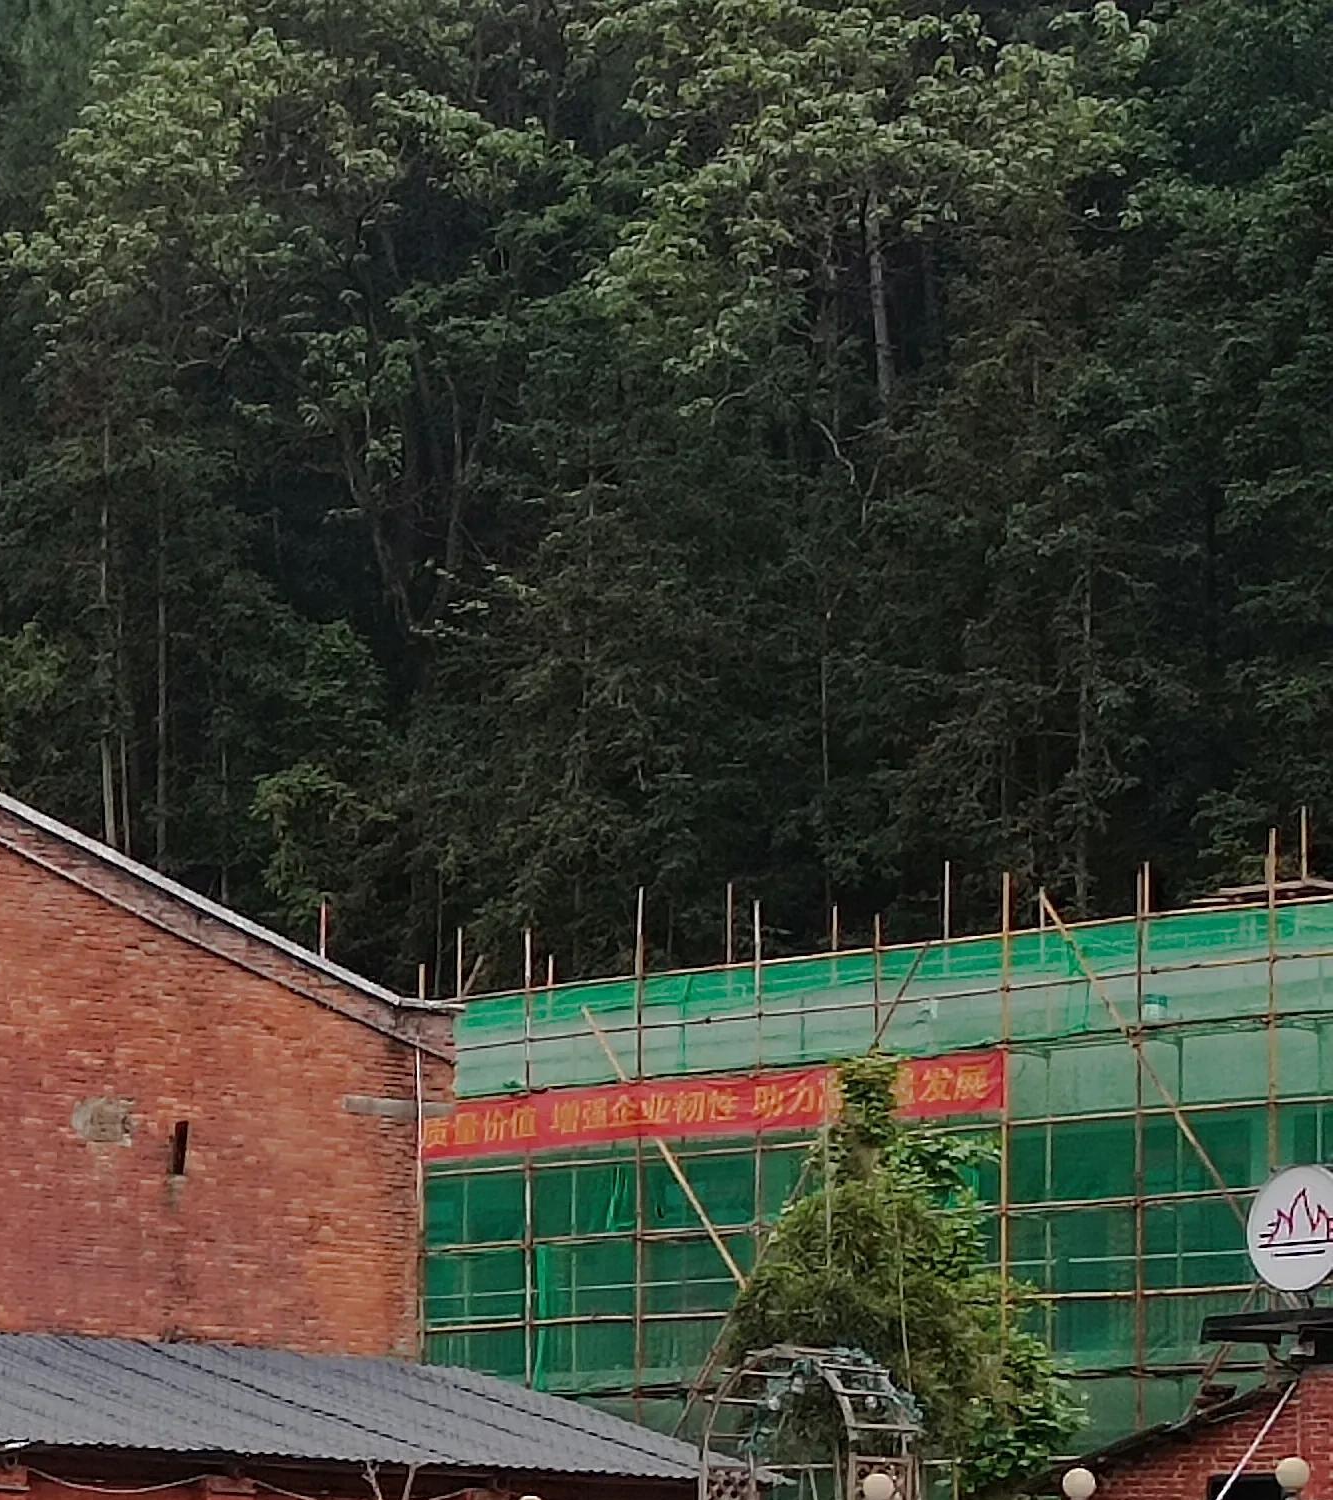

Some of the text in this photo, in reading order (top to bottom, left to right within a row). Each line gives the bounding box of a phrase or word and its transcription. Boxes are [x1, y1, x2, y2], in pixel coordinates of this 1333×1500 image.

[423, 1065, 989, 1149] 质量价值 增强企业韧性 助力量发展
